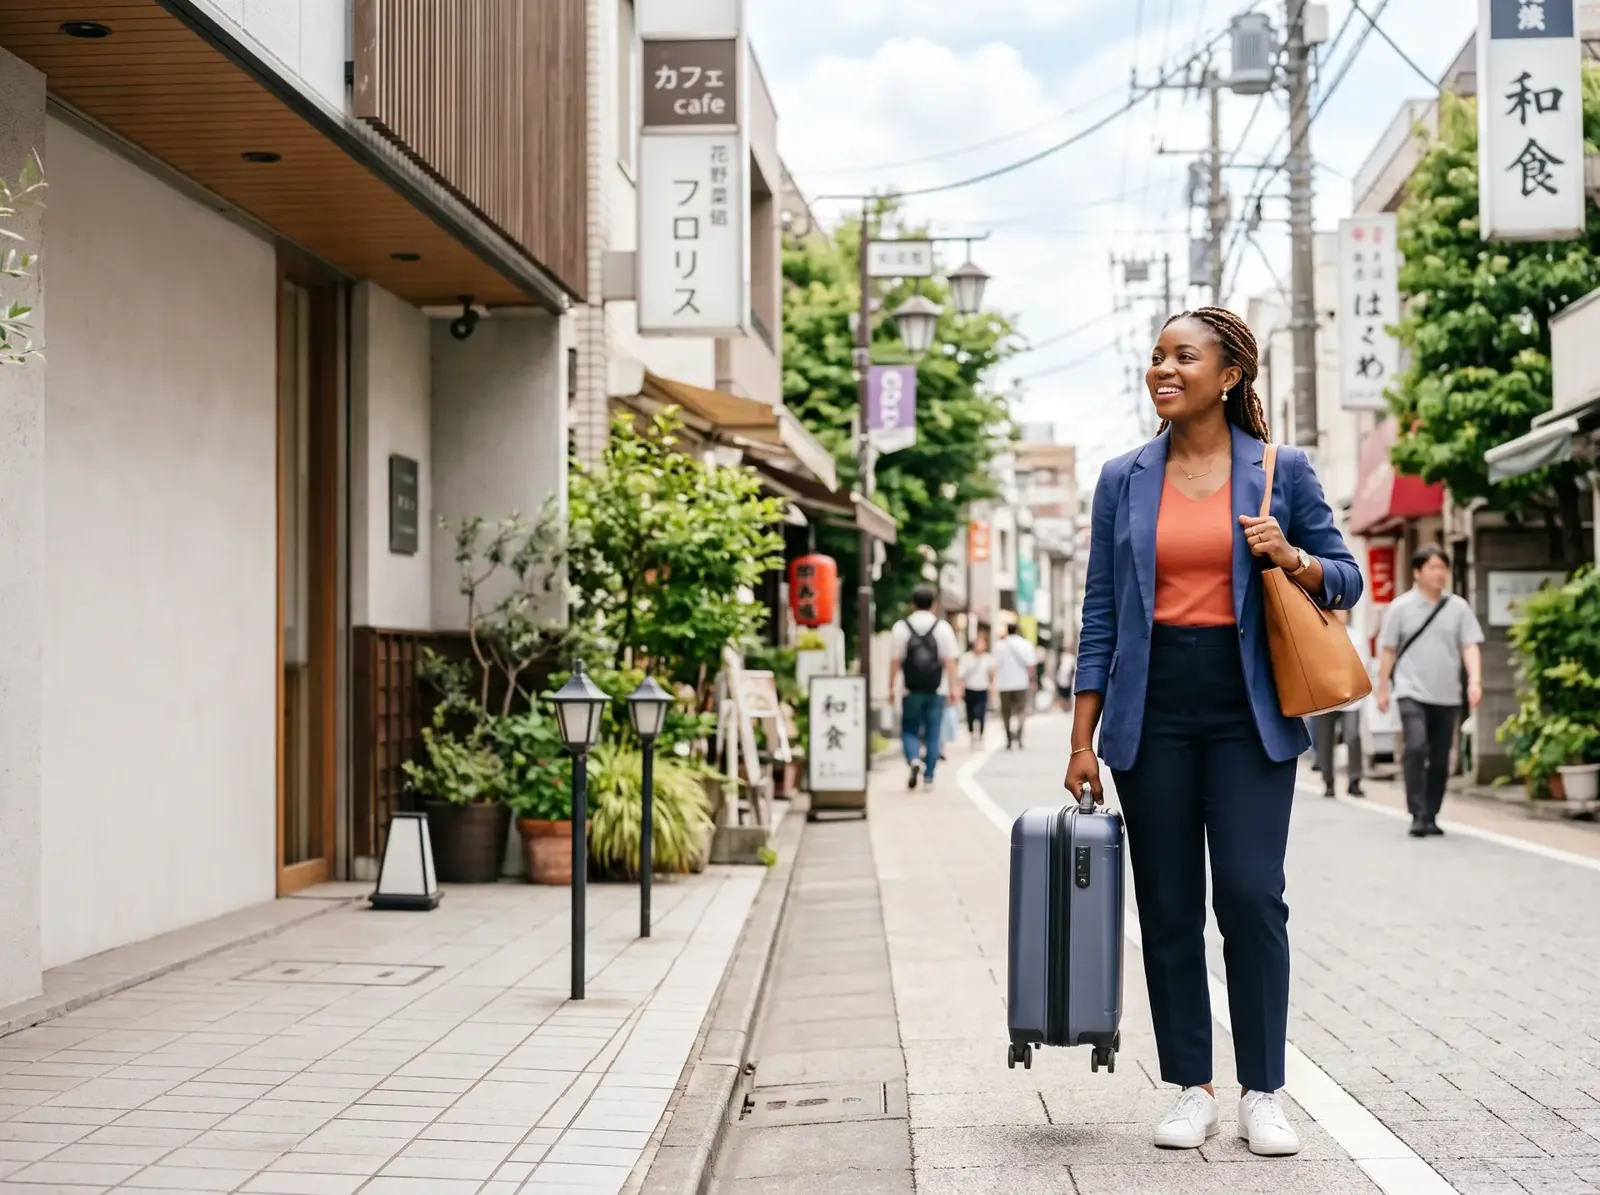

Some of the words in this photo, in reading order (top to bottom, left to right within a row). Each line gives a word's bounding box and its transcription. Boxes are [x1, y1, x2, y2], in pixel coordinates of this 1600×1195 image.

[655, 65, 724, 90] カフェ
[673, 92, 725, 115] cafe
[1505, 71, 1565, 197] 和食
[673, 179, 701, 316] フロリス
[822, 694, 847, 752] 和食
